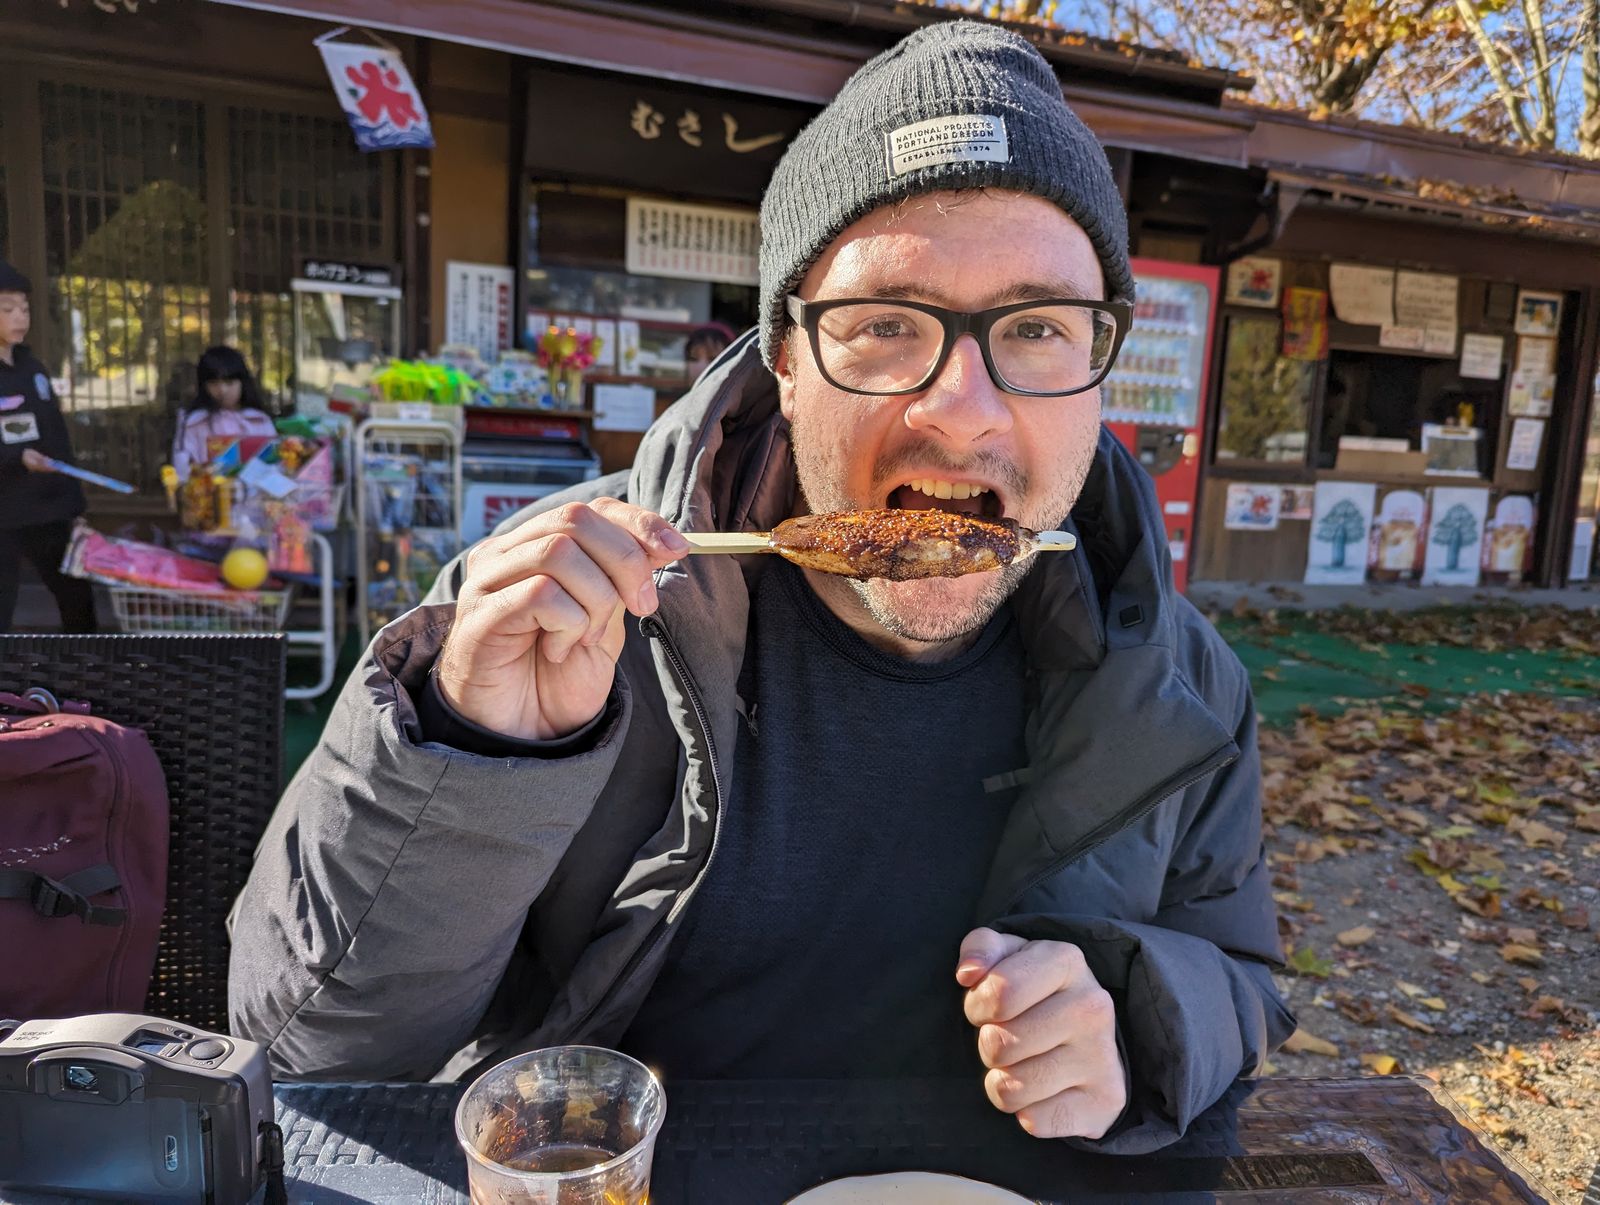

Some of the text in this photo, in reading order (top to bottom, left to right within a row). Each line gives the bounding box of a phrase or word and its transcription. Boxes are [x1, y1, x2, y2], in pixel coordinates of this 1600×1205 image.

[344, 60, 421, 129] 氷
[629, 100, 785, 153] むさし
[896, 122, 994, 143] NATIONAL PROJECTS
[898, 130, 994, 151] PORTLAND OREGON
